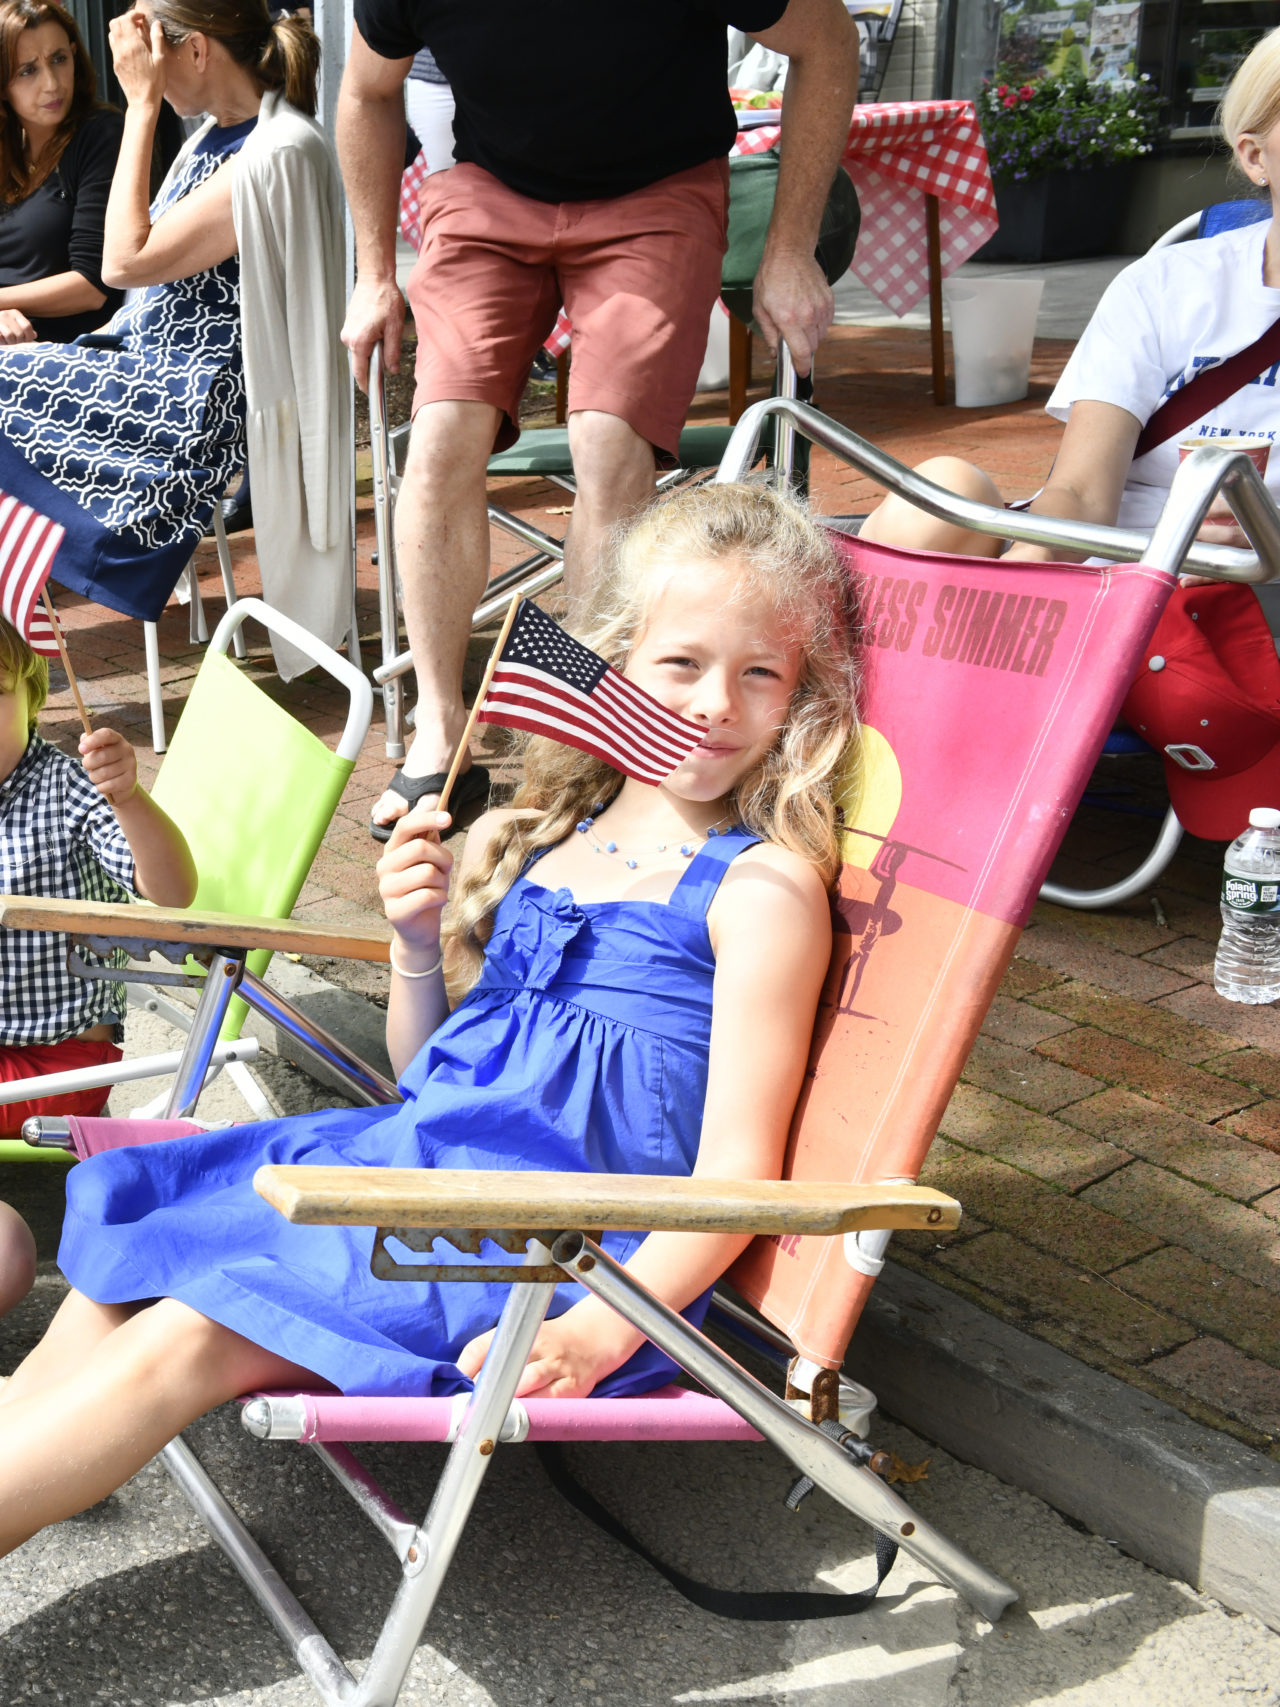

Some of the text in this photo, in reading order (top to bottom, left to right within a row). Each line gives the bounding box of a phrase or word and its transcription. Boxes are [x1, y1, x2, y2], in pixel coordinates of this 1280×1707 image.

[1199, 425, 1277, 441] NEW YORK
[854, 572, 1068, 677] LESS SUMMER
[1225, 880, 1256, 893] Poland
[1225, 889, 1257, 902] Spring
